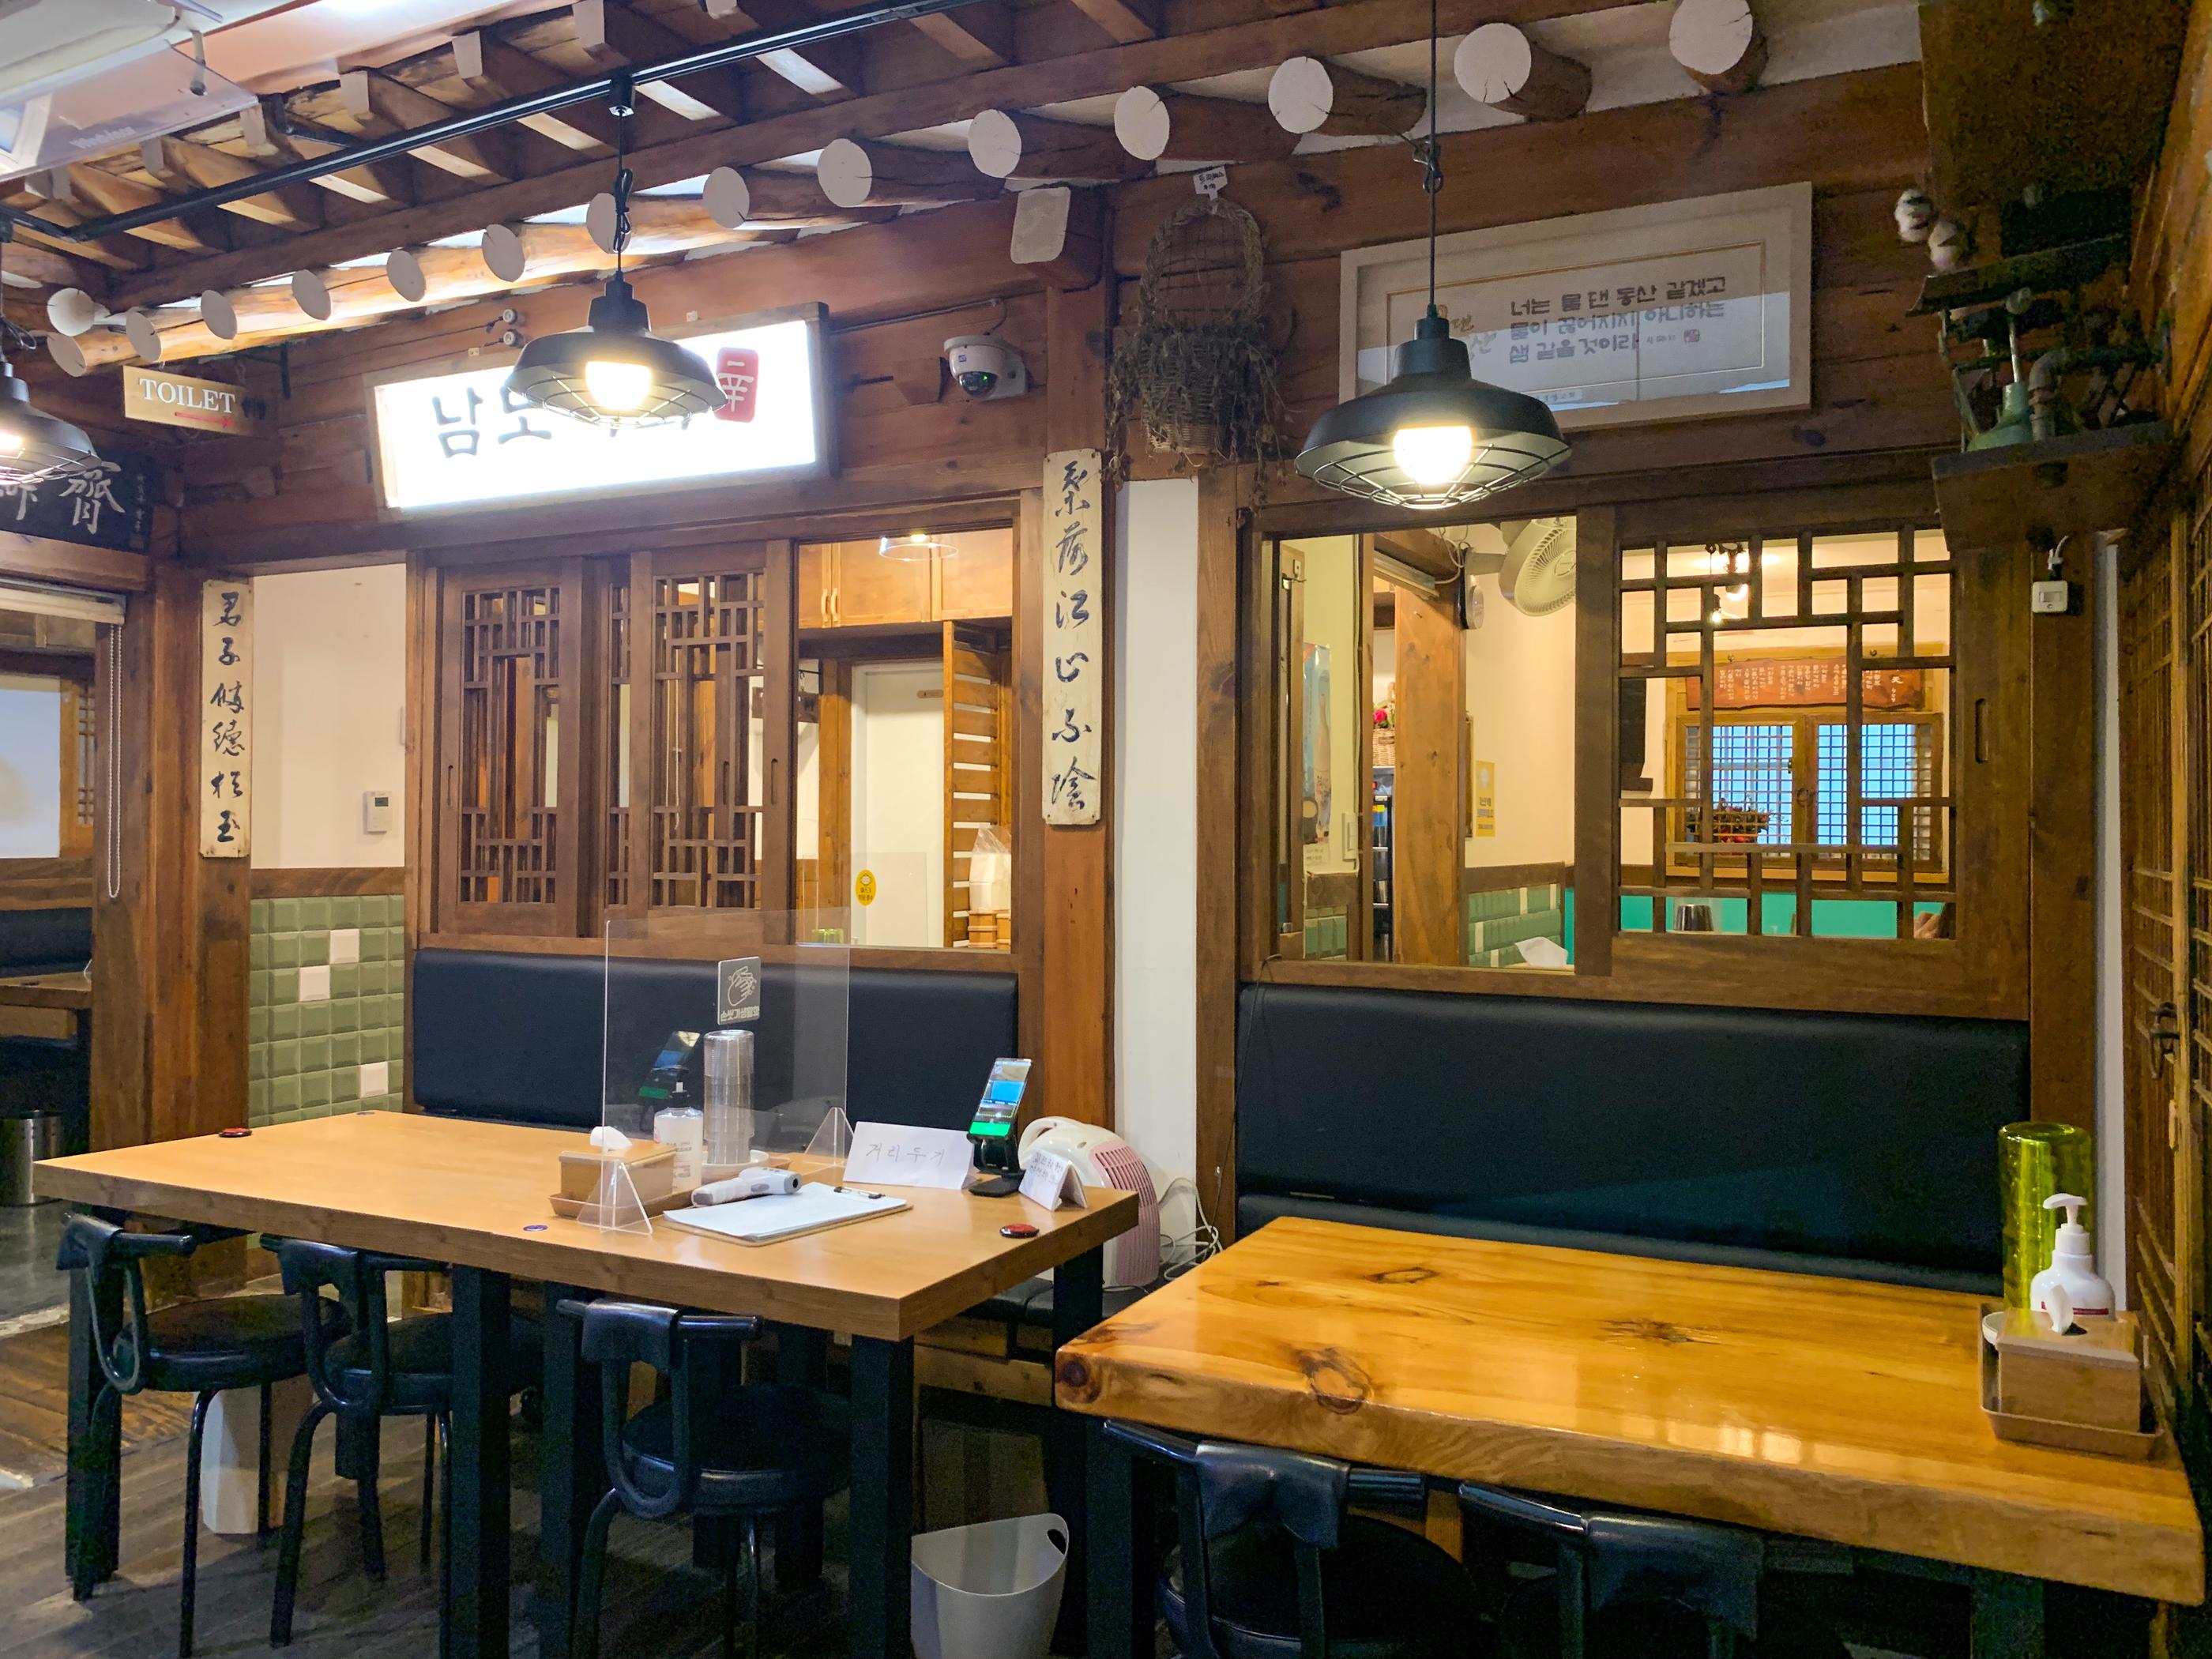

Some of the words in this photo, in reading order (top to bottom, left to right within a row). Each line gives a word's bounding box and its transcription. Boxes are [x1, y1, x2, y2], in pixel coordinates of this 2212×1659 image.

[1510, 298, 1551, 316] 너는
[1561, 293, 1582, 312] 물
[1587, 289, 1609, 309] 댄
[1616, 284, 1658, 306] 동산
[1510, 320, 1548, 340] 물이
[1643, 301, 1726, 322] 아니하는
[139, 378, 236, 414] TOILET
